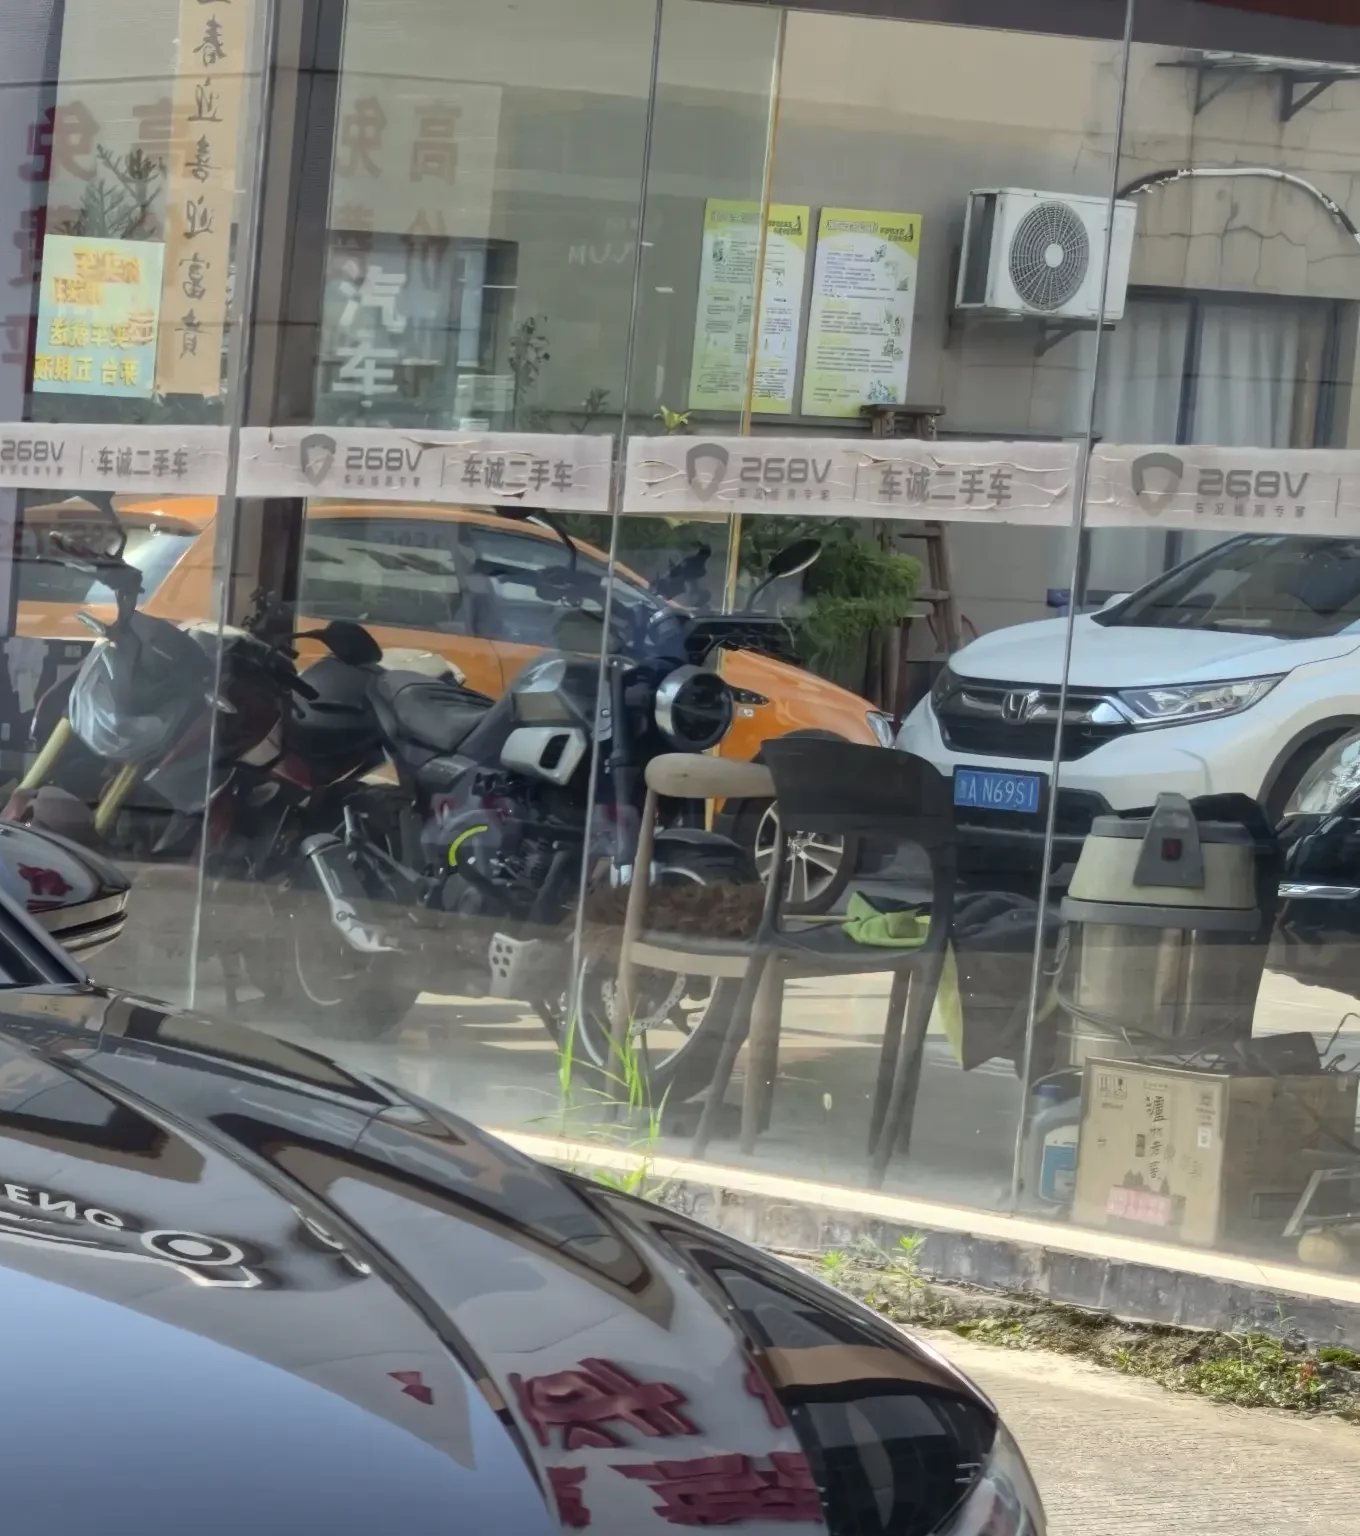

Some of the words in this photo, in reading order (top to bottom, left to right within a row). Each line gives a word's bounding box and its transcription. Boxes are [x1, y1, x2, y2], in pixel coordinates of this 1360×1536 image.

[0, 439, 66, 462] 268V
[96, 446, 188, 477] 车诚二手车
[344, 446, 423, 472] 268V
[460, 454, 573, 492] 车诚二手车
[739, 457, 832, 483] 268V
[877, 464, 1013, 505] 车诚二手车
[1197, 468, 1309, 499] 268V
